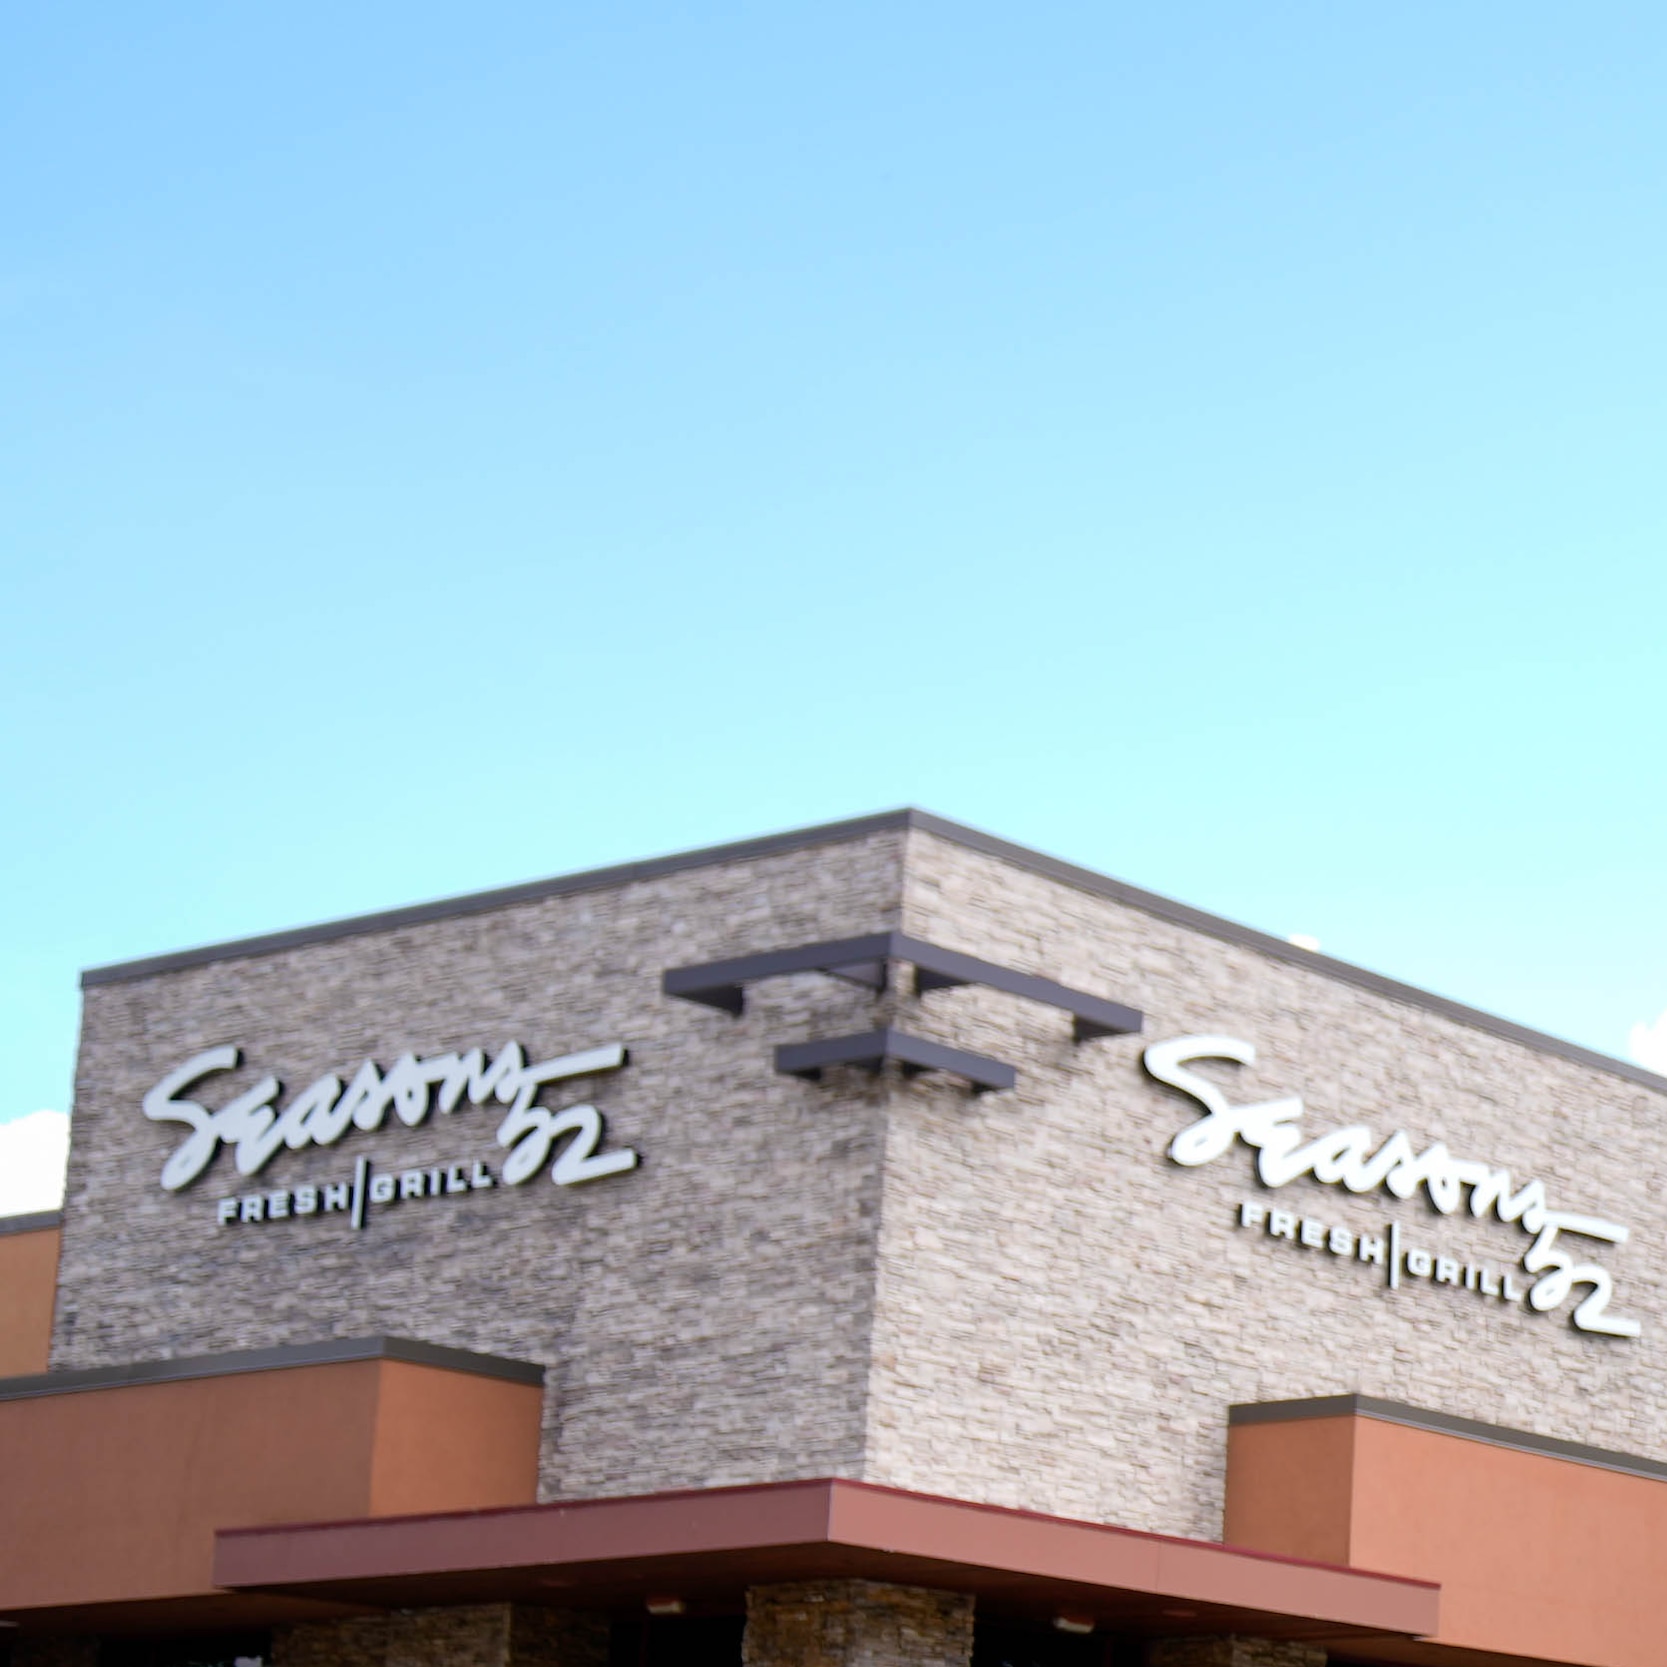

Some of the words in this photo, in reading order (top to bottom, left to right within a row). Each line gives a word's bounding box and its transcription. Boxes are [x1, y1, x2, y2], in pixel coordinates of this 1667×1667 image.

[143, 1041, 538, 1190] Seasons
[497, 1044, 638, 1186] 52
[217, 1175, 348, 1226] FRESH
[369, 1158, 496, 1203] GRILL
[1144, 1035, 1567, 1233] Seasons
[1523, 1211, 1641, 1337] 52
[1239, 1200, 1383, 1266] FRESH
[1405, 1252, 1527, 1303] GRILL
